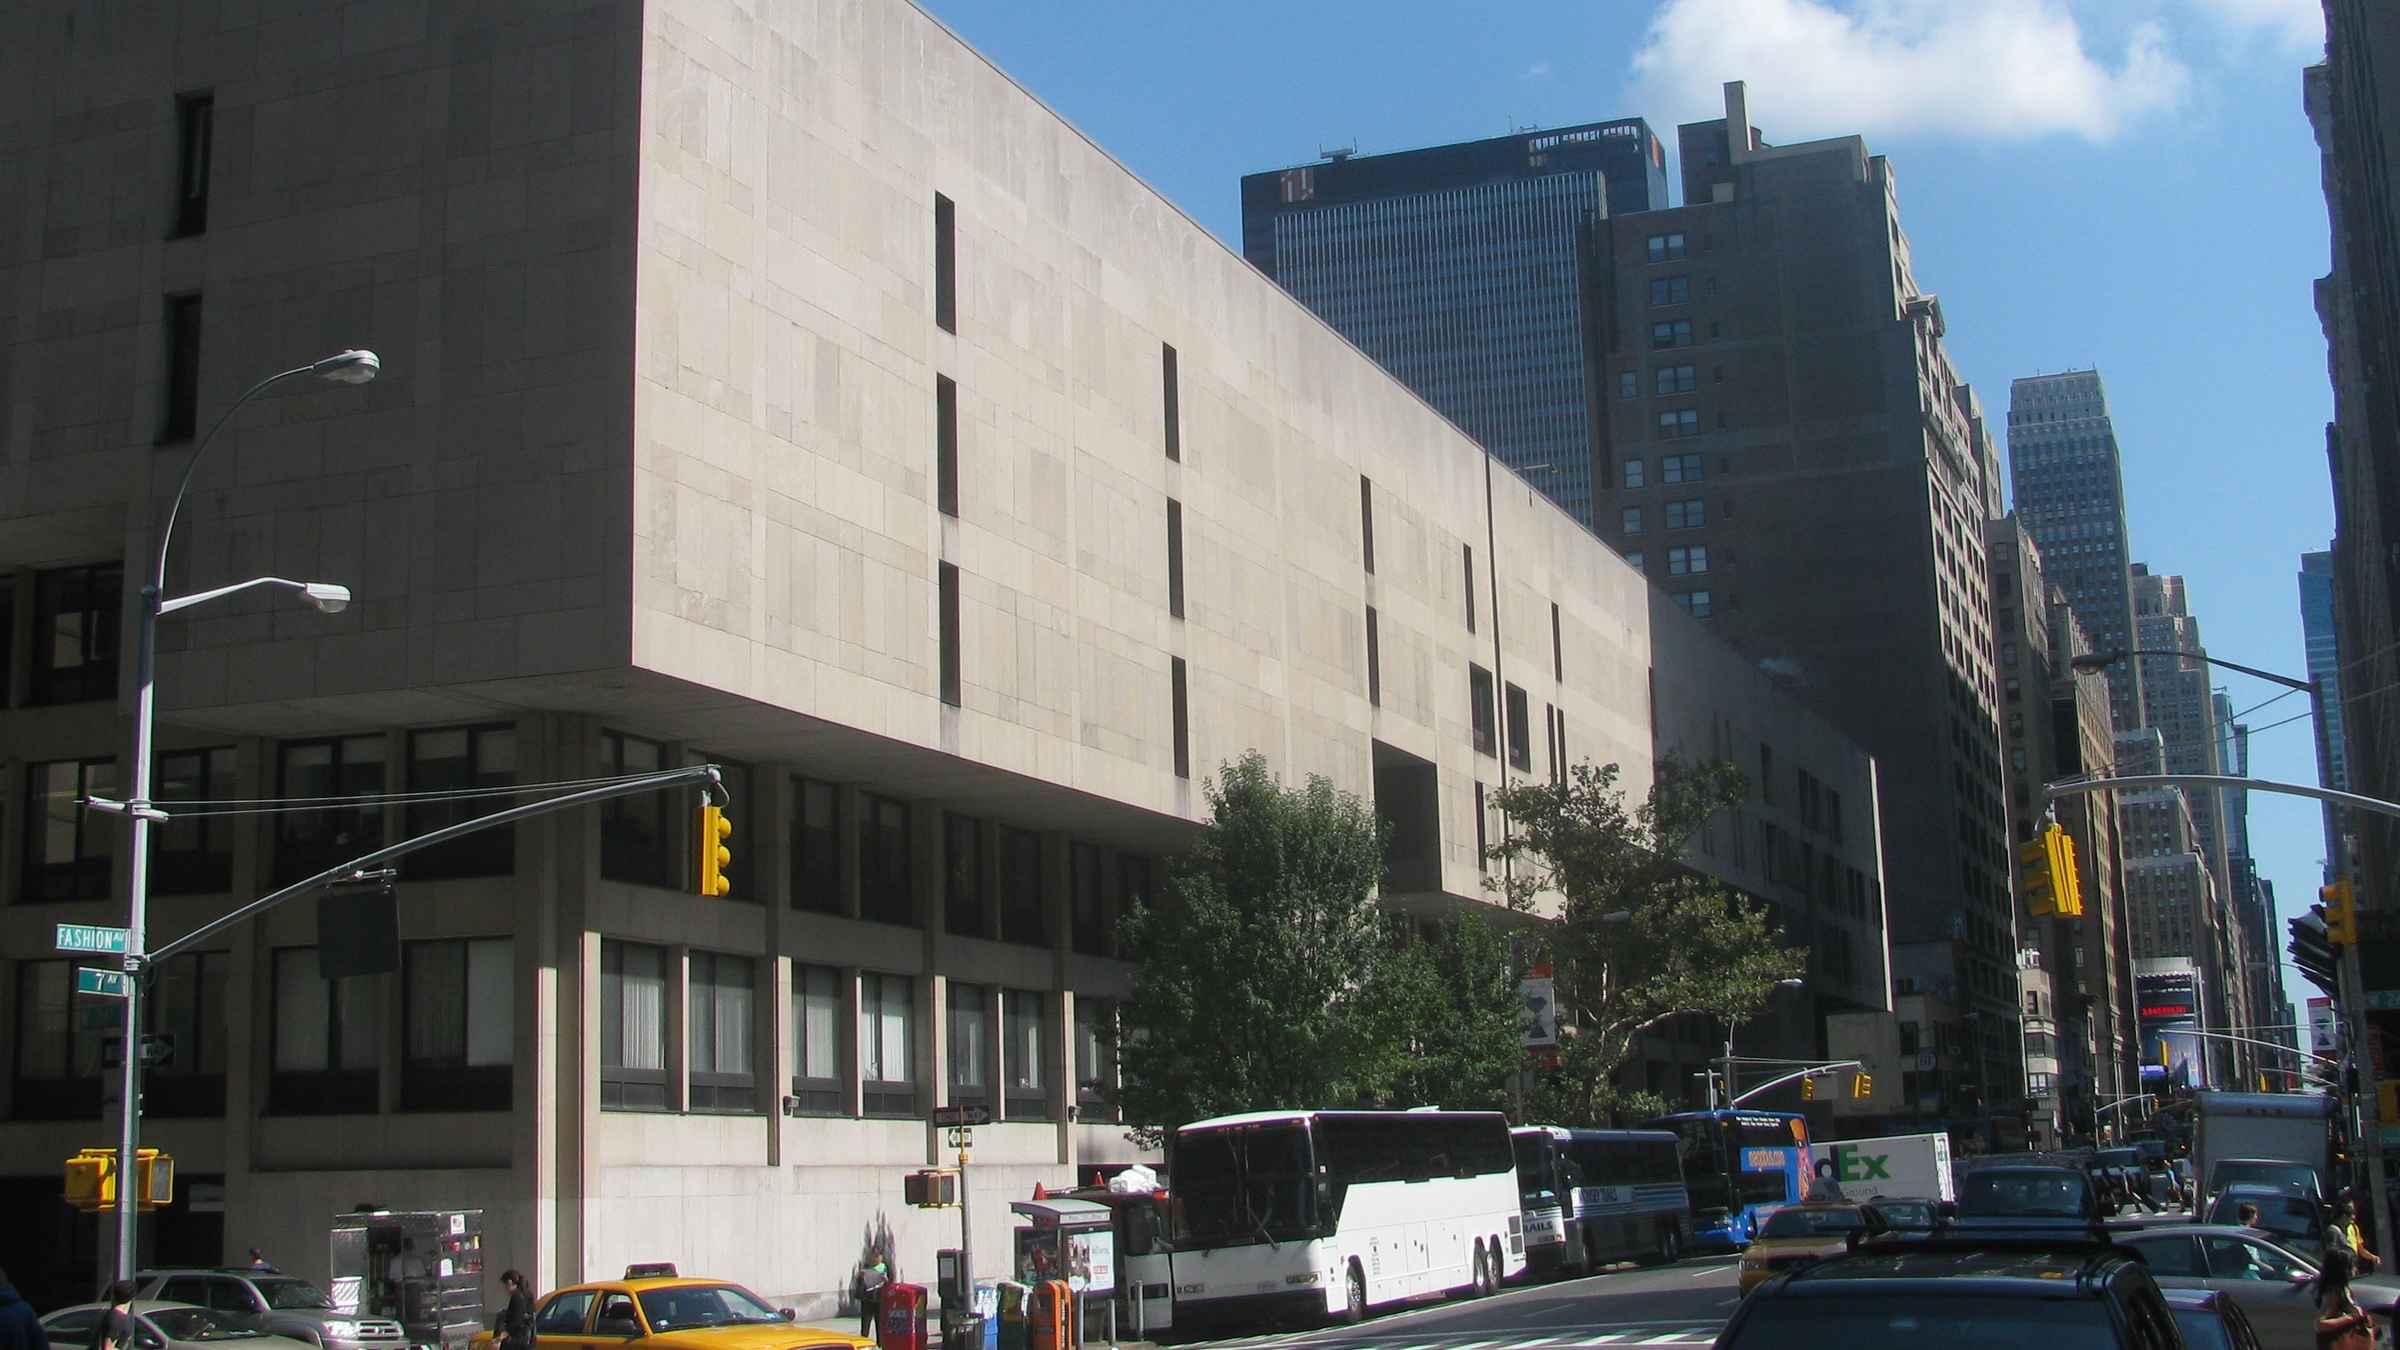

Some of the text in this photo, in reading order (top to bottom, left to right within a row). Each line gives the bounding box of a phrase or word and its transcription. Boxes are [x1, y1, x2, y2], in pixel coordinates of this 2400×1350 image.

[58, 928, 113, 949] FASHION
[95, 973, 119, 991] 7 AV
[1814, 1144, 1891, 1181] dEx
